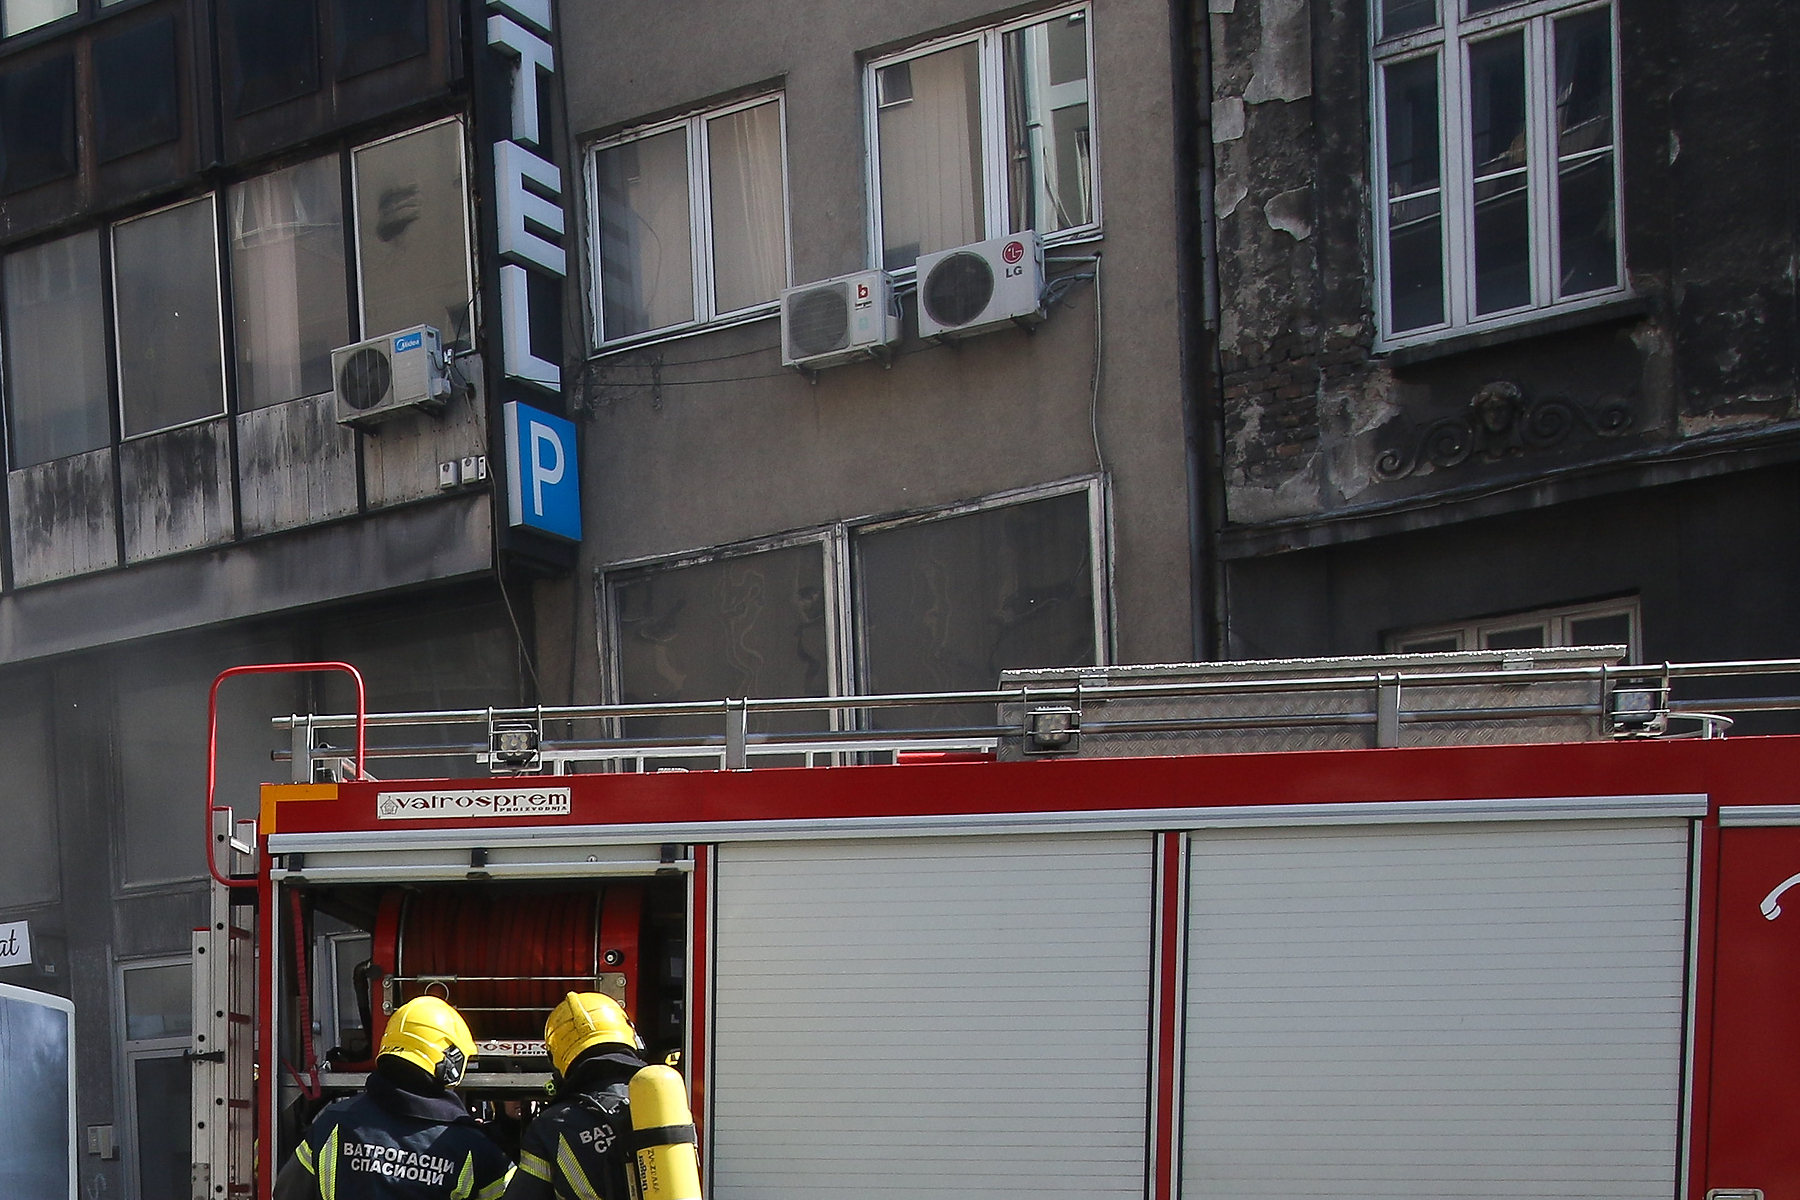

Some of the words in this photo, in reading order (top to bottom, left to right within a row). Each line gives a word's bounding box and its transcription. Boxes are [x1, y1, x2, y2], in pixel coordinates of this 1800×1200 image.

[487, 0, 567, 392] TEL
[1006, 266, 1023, 278] LG
[530, 420, 565, 517] P
[343, 1143, 455, 1174] ВАТРОГАСЦИ
[351, 1158, 444, 1185] СПАСИОЦИ
